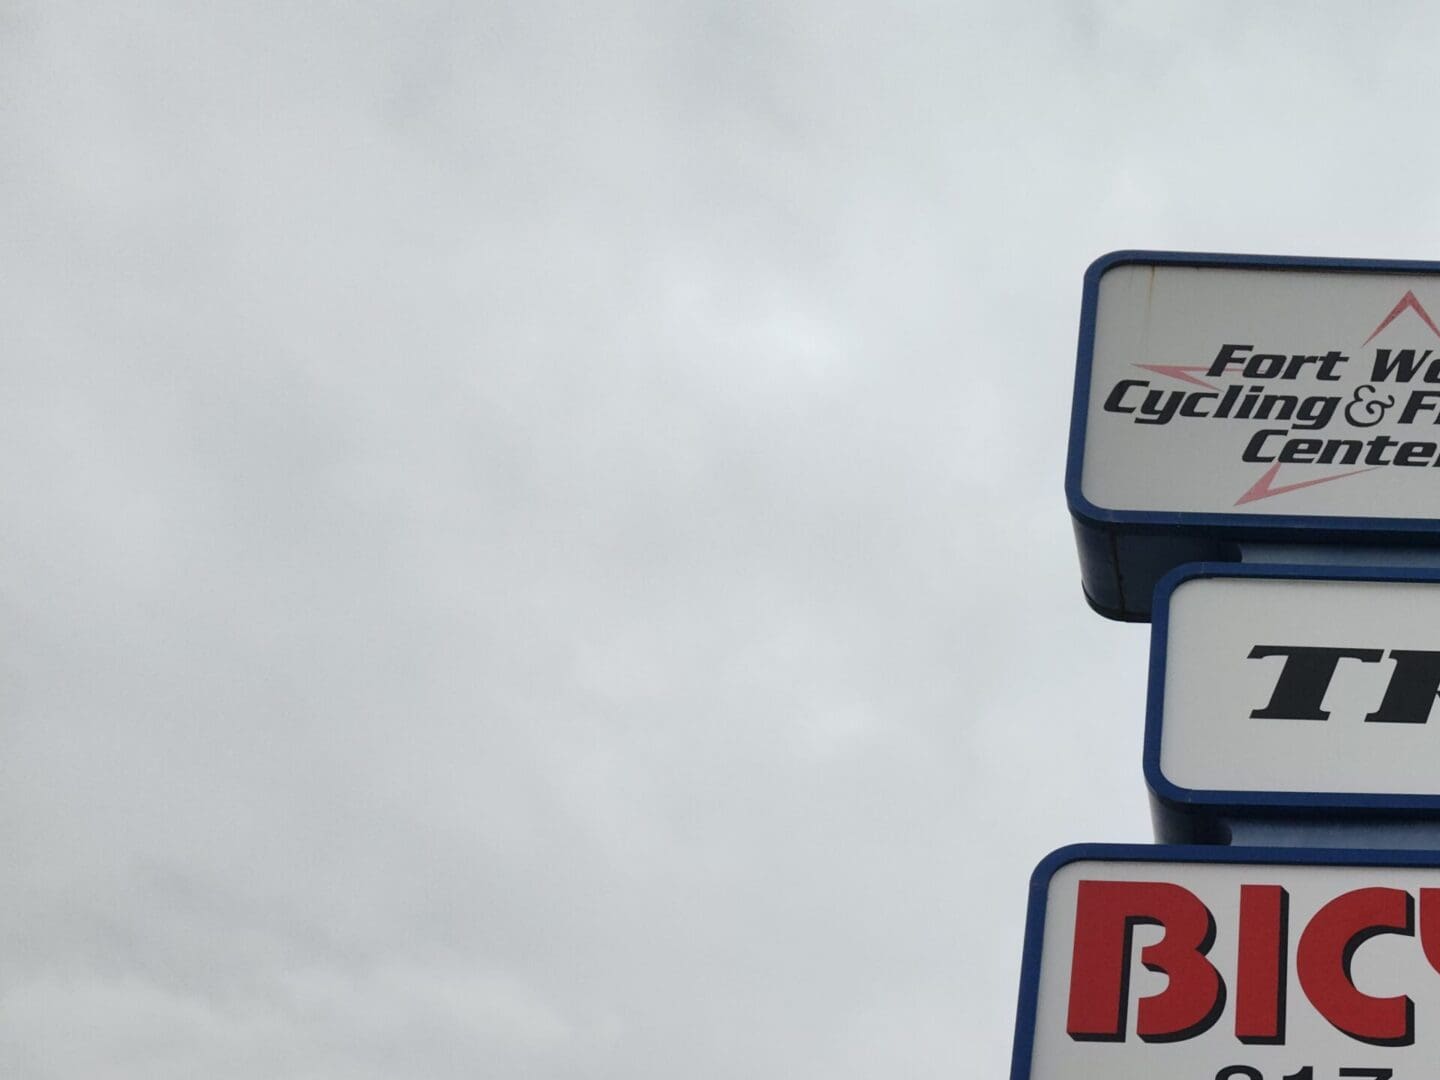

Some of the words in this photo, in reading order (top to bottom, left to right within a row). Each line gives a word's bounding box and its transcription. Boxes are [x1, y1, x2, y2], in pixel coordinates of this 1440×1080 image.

[1206, 344, 1350, 383] Fort
[1104, 380, 1343, 431] Cycling
[1344, 384, 1396, 428] &
